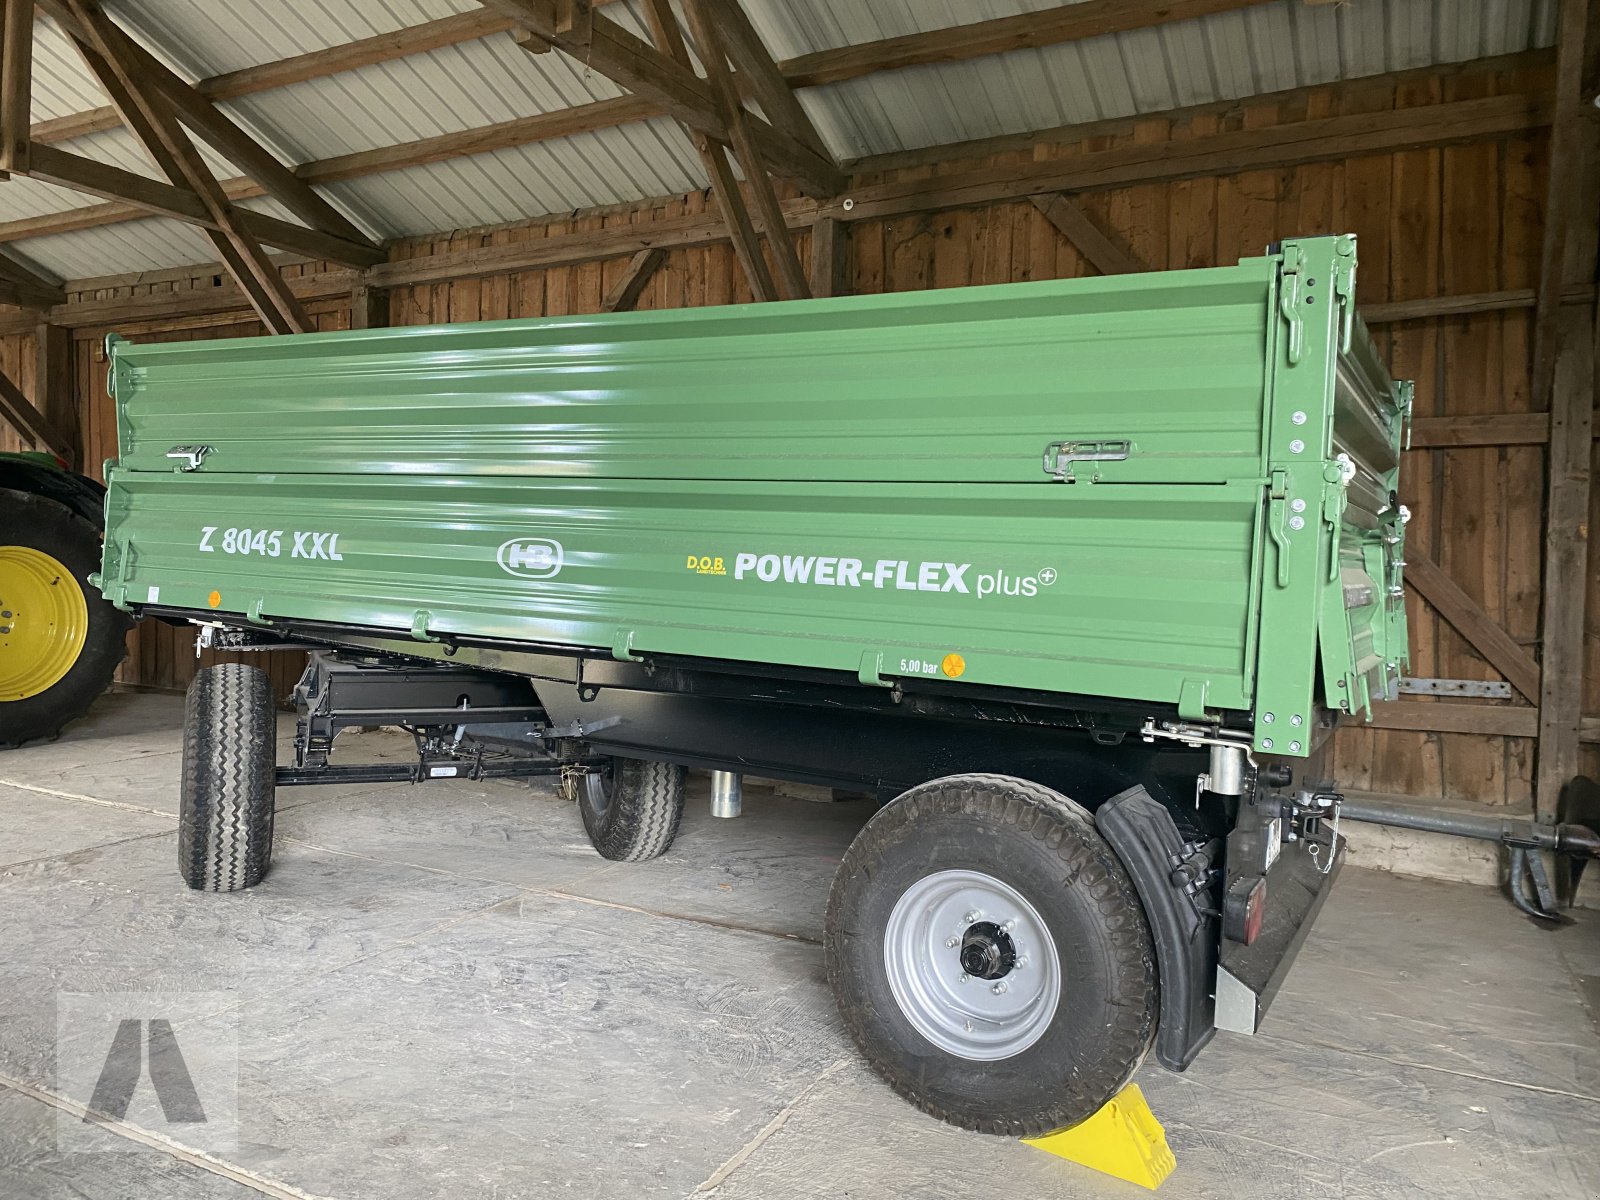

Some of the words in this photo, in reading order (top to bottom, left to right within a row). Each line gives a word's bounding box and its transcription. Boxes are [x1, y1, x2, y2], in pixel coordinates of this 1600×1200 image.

[199, 526, 219, 552] Z
[221, 527, 284, 557] 8045
[290, 531, 343, 561] XXL
[686, 555, 726, 571] D.O.B.
[734, 552, 972, 594] POWER-FLEX
[976, 569, 1038, 599] plus
[900, 658, 921, 674] 5,00
[922, 660, 939, 674] bar
